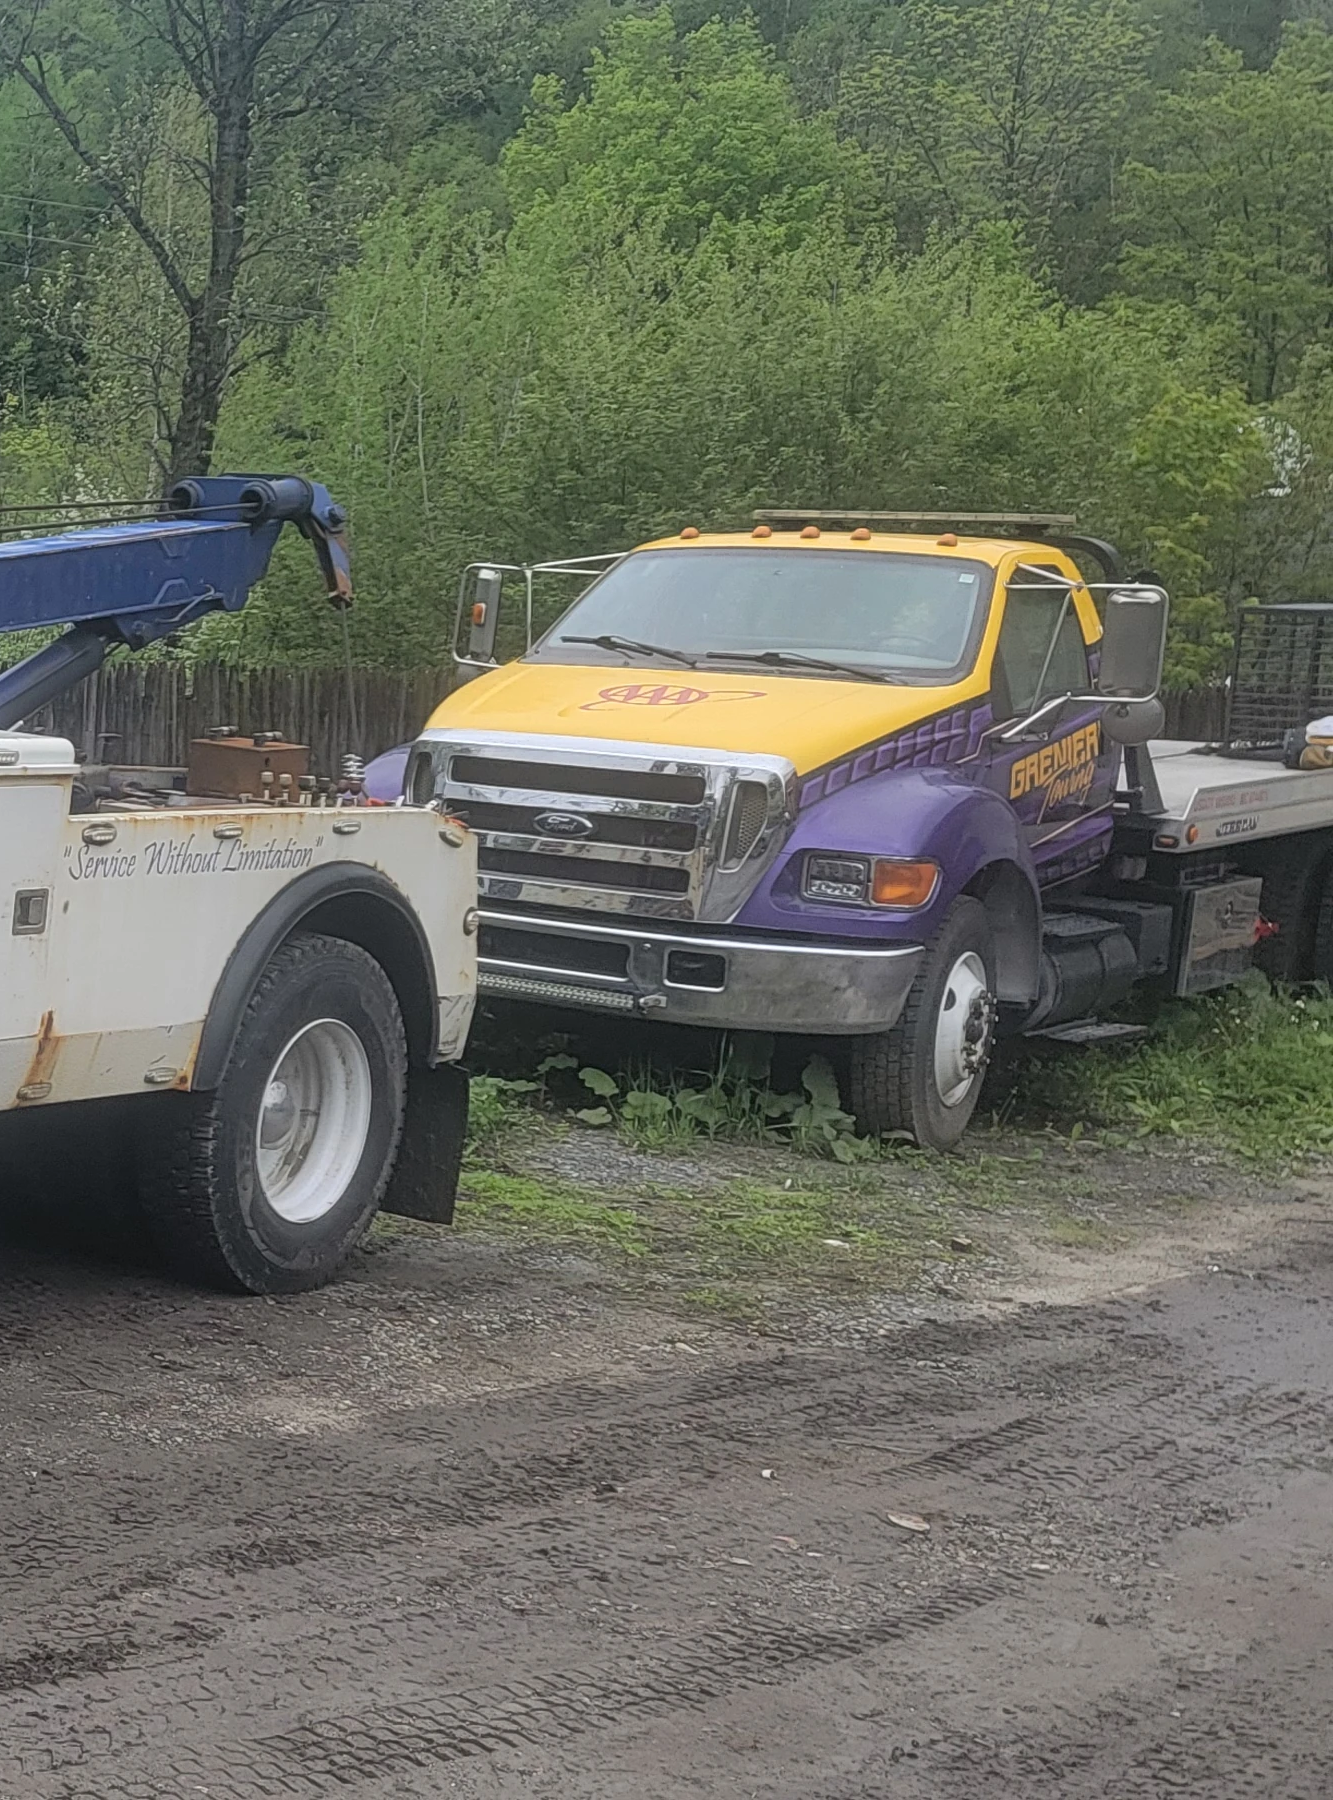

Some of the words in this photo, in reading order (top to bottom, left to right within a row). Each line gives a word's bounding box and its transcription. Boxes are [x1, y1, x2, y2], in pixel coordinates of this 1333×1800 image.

[605, 684, 699, 706] AAA
[1036, 760, 1096, 825] Towing
[544, 815, 579, 832] Ford
[63, 844, 137, 881] "Service
[144, 833, 223, 876] Without
[222, 835, 324, 873] Limitation"
